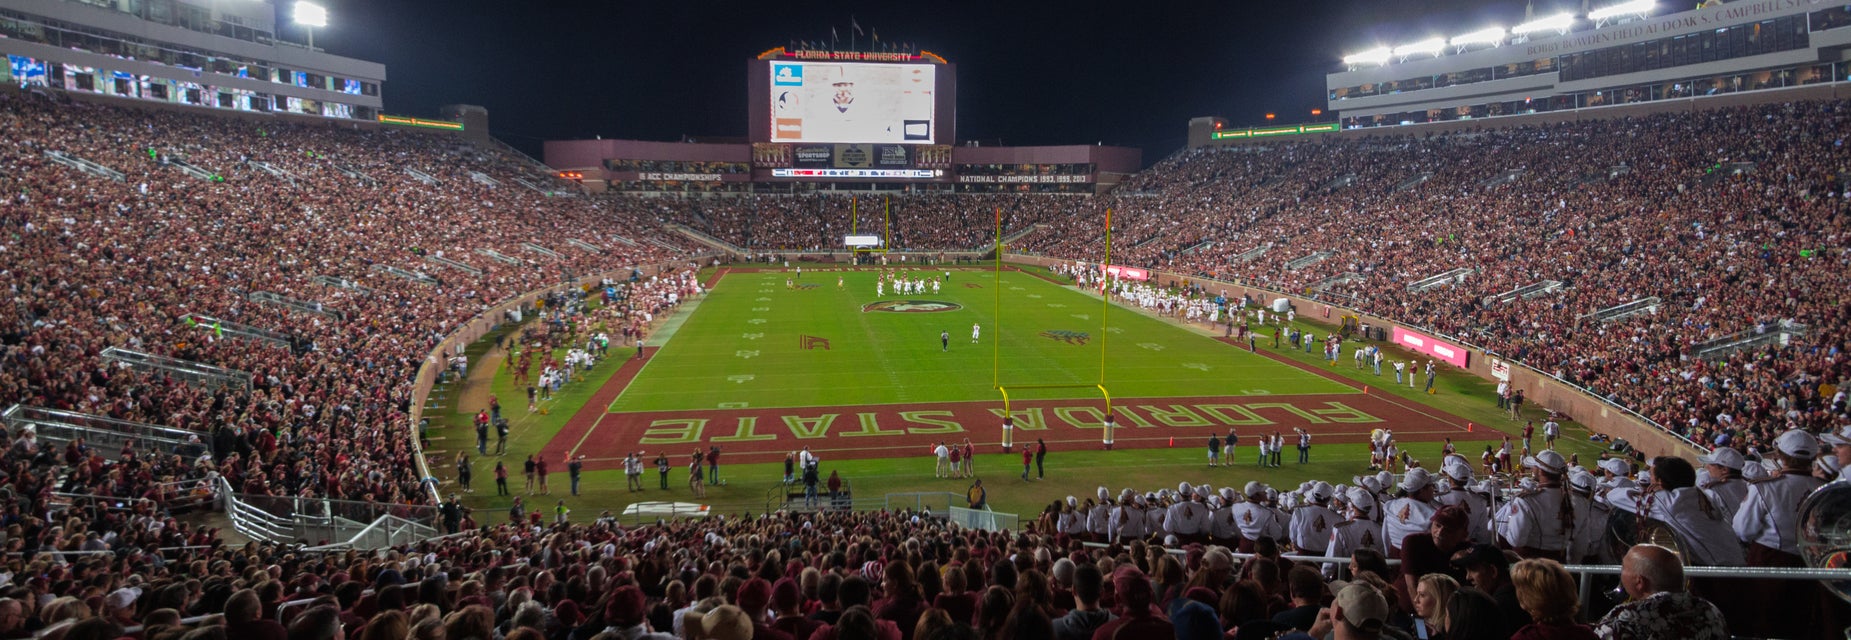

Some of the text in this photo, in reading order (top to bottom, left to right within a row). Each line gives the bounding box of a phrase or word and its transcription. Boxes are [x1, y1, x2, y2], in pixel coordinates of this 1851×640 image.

[1527, 42, 1559, 56] BOBBY
[1562, 33, 1610, 49] BOWDEN
[1613, 25, 1643, 40] FIELD
[1646, 23, 1658, 34] AT
[1662, 15, 1698, 32] DOAK
[1715, 0, 1782, 21] CAMPBELL
[795, 50, 912, 62] FLORIDA STATE UNIVERSITY
[647, 172, 662, 180] ACC
[663, 172, 722, 181] CHAMPIONSHIPS
[960, 175, 995, 183] NATIONAL
[997, 175, 1038, 183] CHAMPIONS
[1073, 175, 1086, 183] 2013
[638, 401, 1387, 445] FLORIDA STATE
